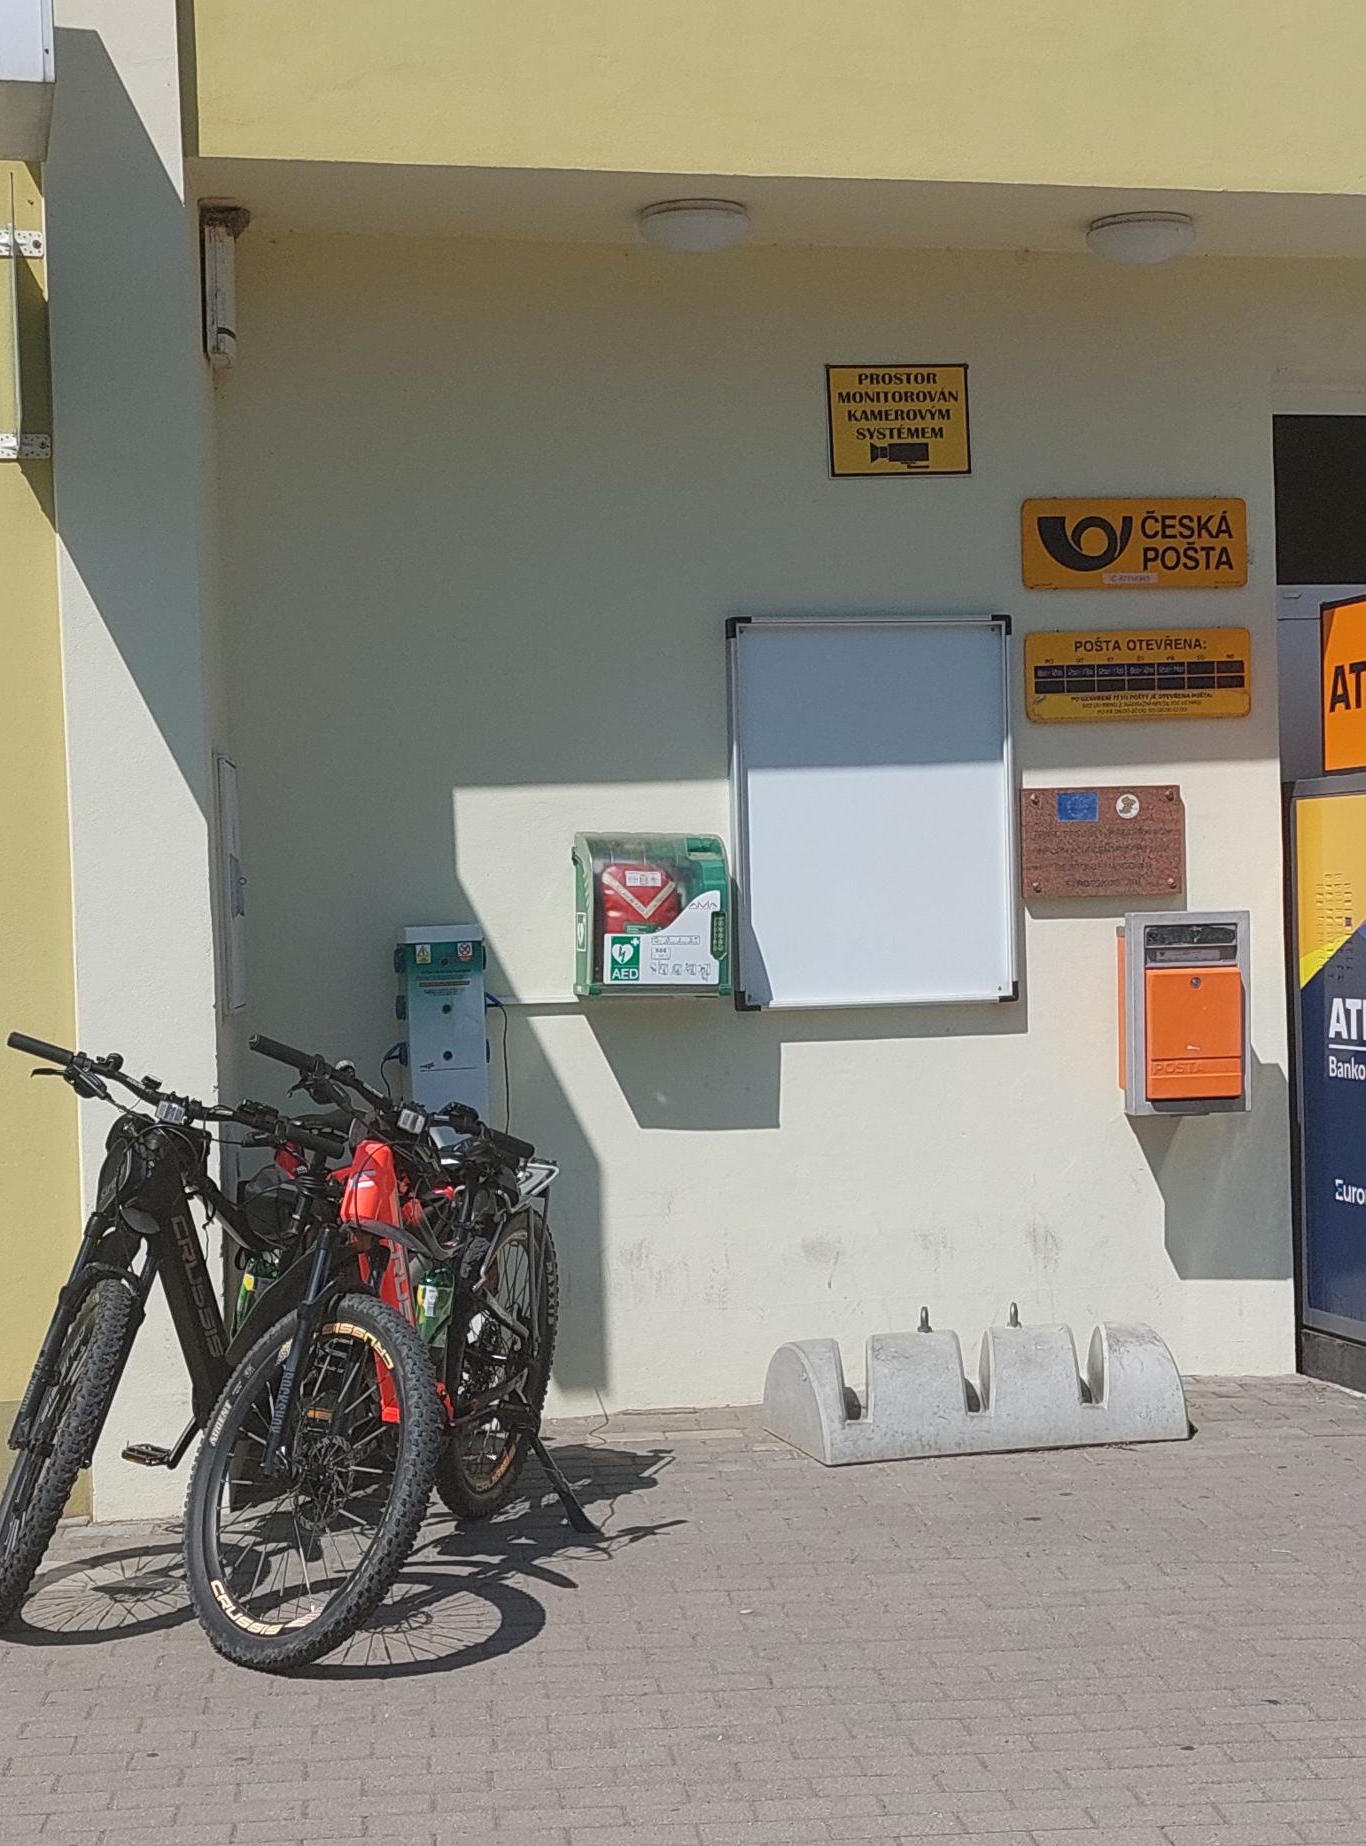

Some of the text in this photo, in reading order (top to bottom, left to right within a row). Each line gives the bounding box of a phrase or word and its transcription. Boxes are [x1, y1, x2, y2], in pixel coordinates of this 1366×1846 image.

[857, 372, 938, 386] PROSTOR
[837, 390, 959, 404] MONITOROVÁN
[847, 405, 951, 422] KAMEROVÝM
[855, 424, 944, 440] SYSTÉMEM
[1140, 510, 1234, 540] ČESKÁ
[1142, 541, 1235, 571] POŠTA
[1073, 634, 1207, 653] POŠTA OTEVŘENA:
[612, 969, 639, 980] AED
[171, 1215, 224, 1358] CRUSSIS
[210, 1579, 284, 1636] CRUSSIS
